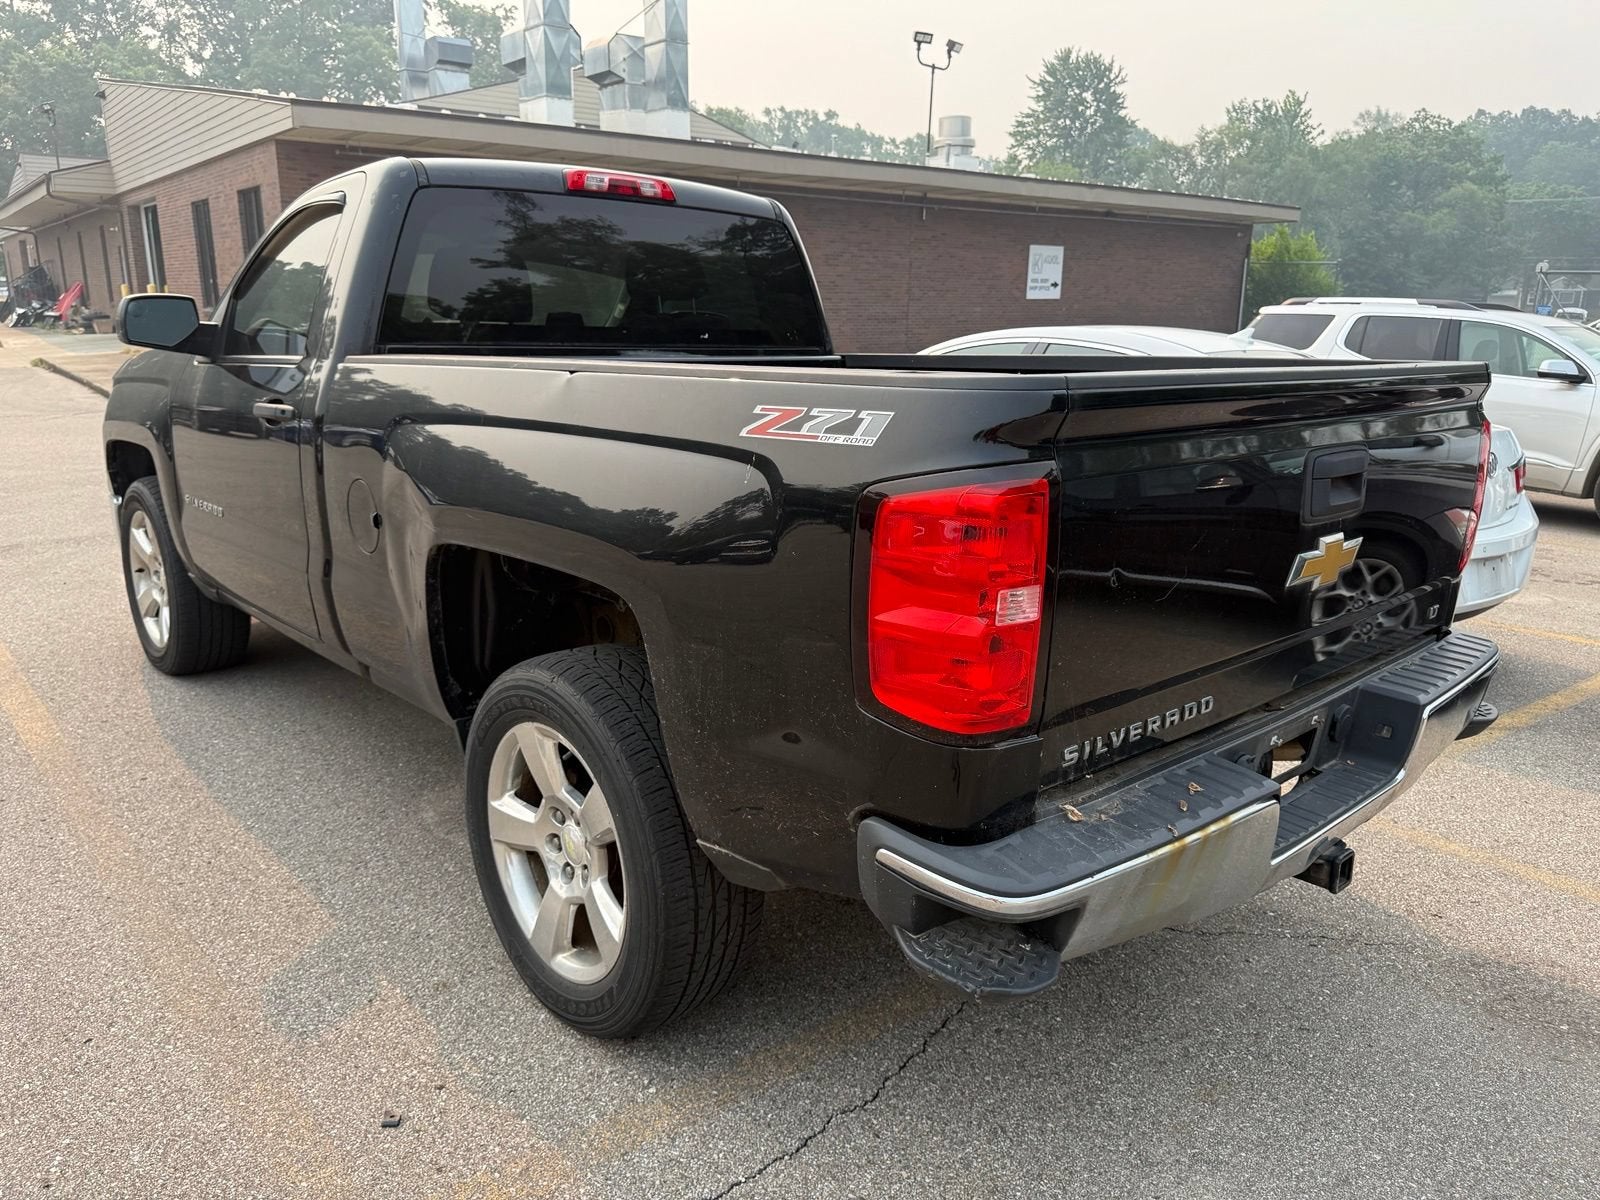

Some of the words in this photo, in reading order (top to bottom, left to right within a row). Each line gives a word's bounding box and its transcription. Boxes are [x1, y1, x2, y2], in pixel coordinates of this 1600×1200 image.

[739, 405, 895, 444] Z71
[819, 435, 841, 443] OFF
[842, 437, 874, 446] ROAD
[1061, 695, 1215, 768] SILVERADO
